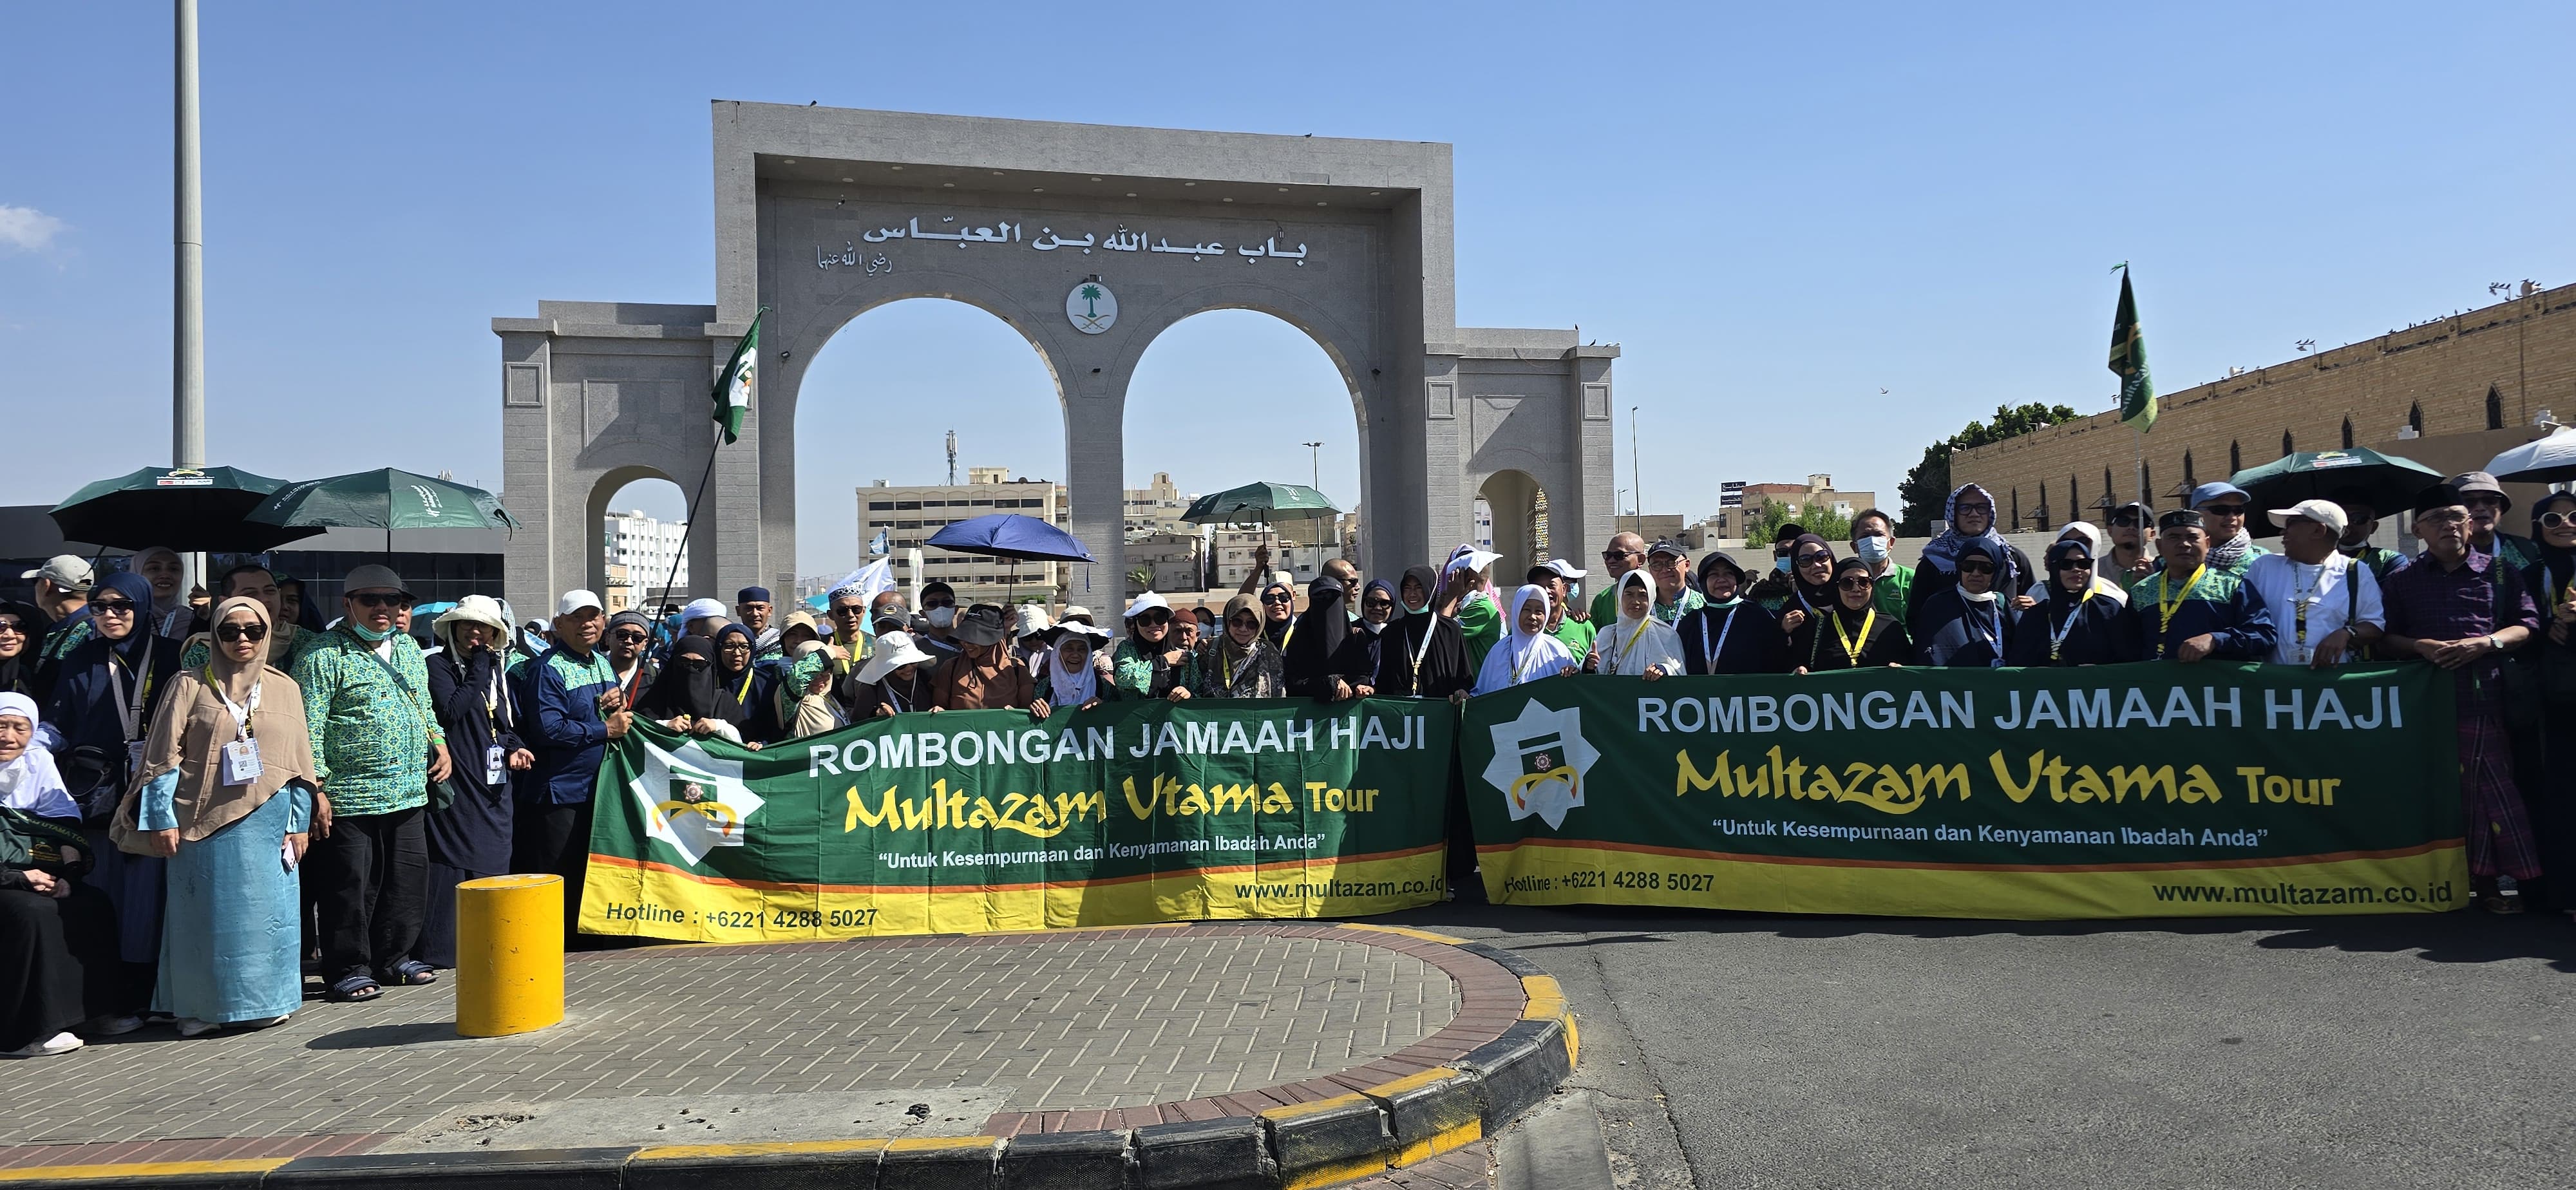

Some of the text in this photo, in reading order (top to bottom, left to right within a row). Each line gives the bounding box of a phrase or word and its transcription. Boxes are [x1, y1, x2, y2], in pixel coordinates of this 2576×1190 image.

[1032, 227, 1095, 255] بن
[1238, 237, 1307, 266] باب
[866, 252, 892, 276] رضي
[1638, 685, 2403, 733] ROMBONGAN JAMAAH HAJI
[809, 715, 1425, 778] ROMBONGAN JAMAAH HAJI
[1676, 744, 2341, 815] Multazam Utama Tour
[844, 771, 1379, 839] Multazam Utama Tour
[1783, 821, 1928, 842] Kesempurnaan
[1934, 824, 1972, 842] dan
[1978, 825, 2115, 847] Kenyamanan
[2121, 827, 2194, 845] Ibadah
[943, 847, 1068, 867] Kesempurnaan
[1074, 844, 1104, 861] dan
[1109, 837, 1209, 860] Kenyamanan
[1215, 835, 1270, 851] Ibadah
[1504, 875, 1550, 893] Hotline
[1562, 871, 1605, 889] +6221
[1613, 871, 1660, 890] 4288
[1667, 873, 1714, 892] 5027
[2152, 880, 2453, 905] www.multazam.co.id
[607, 902, 685, 923] Hotline
[706, 911, 764, 928] +6221
[773, 911, 822, 927] 4288
[829, 909, 878, 927] 5027
